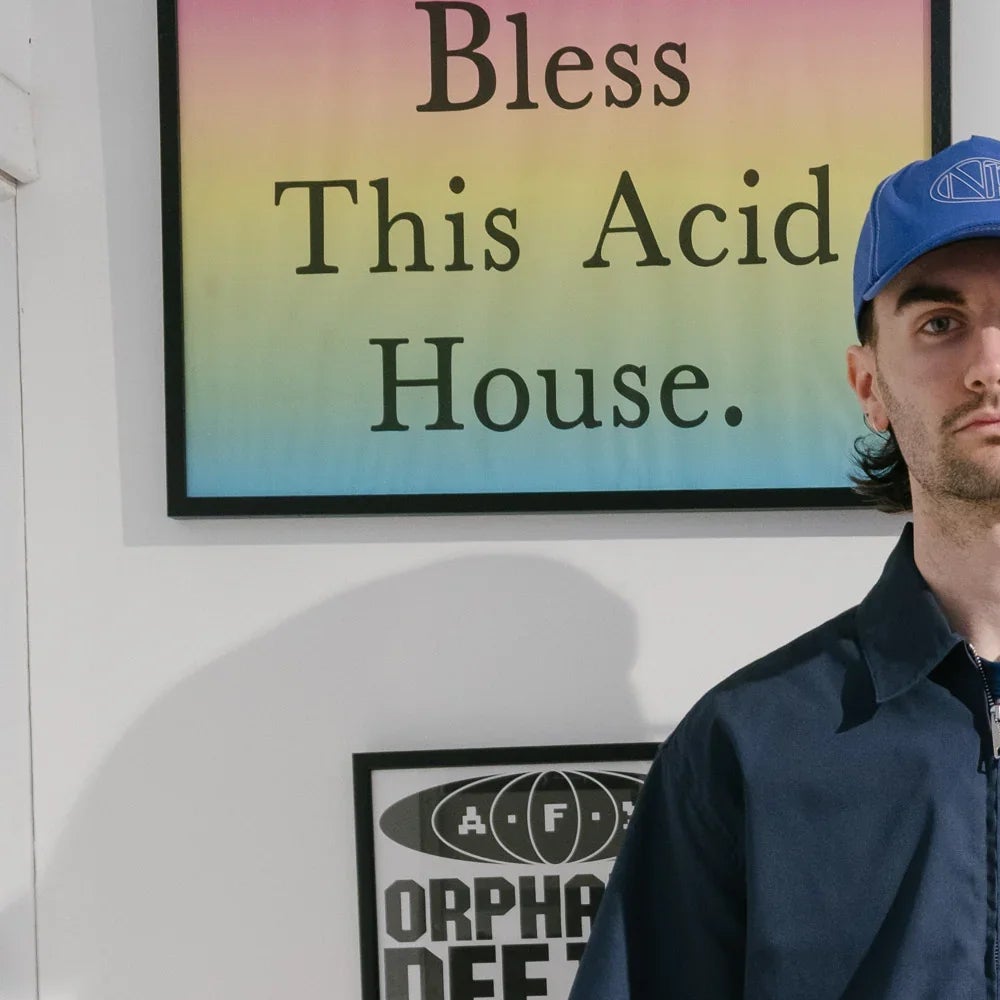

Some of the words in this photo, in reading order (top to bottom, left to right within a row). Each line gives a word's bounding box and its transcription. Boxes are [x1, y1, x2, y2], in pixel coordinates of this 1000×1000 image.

[415, 1, 690, 112] Bless
[274, 175, 521, 275] This
[582, 164, 839, 269] Acid
[369, 336, 743, 432] House.
[384, 873, 611, 943] ORPHA
